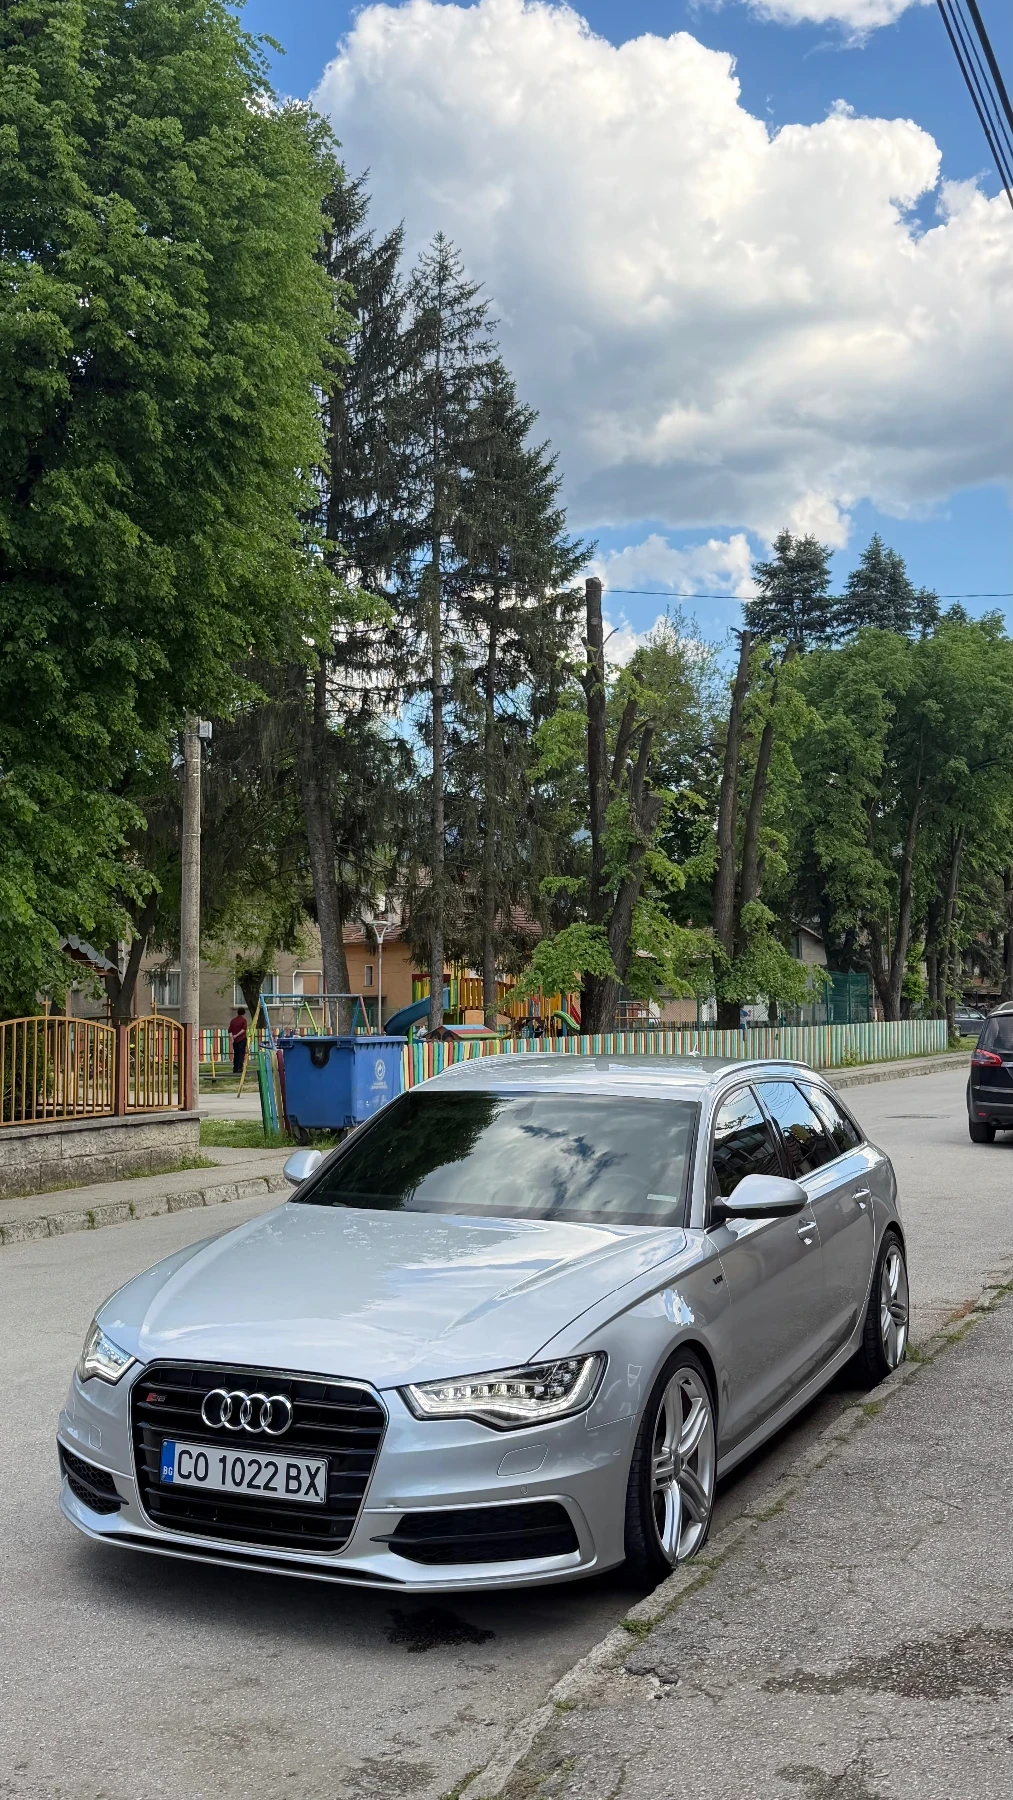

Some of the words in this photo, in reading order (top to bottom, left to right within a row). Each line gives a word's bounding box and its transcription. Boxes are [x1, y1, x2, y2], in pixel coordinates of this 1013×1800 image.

[162, 1465, 173, 1476] BG
[218, 1454, 279, 1492] 1022
[285, 1462, 322, 1497] BX
